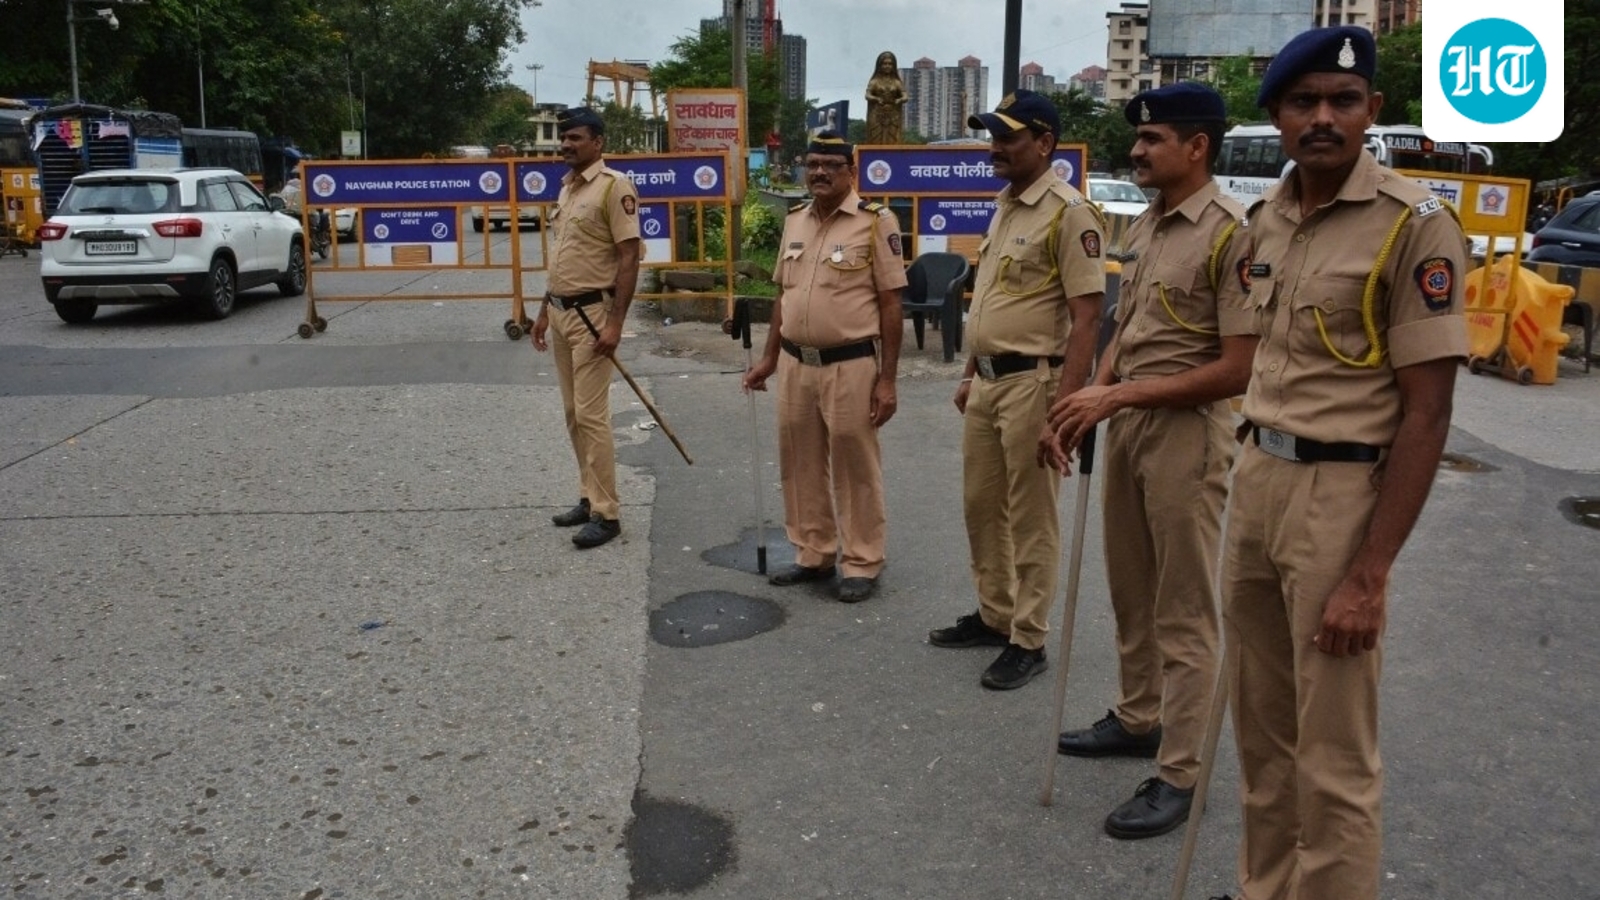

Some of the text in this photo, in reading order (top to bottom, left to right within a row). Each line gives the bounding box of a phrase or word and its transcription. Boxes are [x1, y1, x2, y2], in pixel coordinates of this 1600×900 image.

[675, 102, 737, 119] सावधान
[691, 128, 715, 139] काम
[715, 128, 740, 144] चालू
[1386, 136, 1465, 155] RADHA KRISHNA
[649, 169, 676, 185] ठाणे
[909, 165, 950, 178] नवघर
[345, 179, 471, 190] NAVGHAR POLICE STATION
